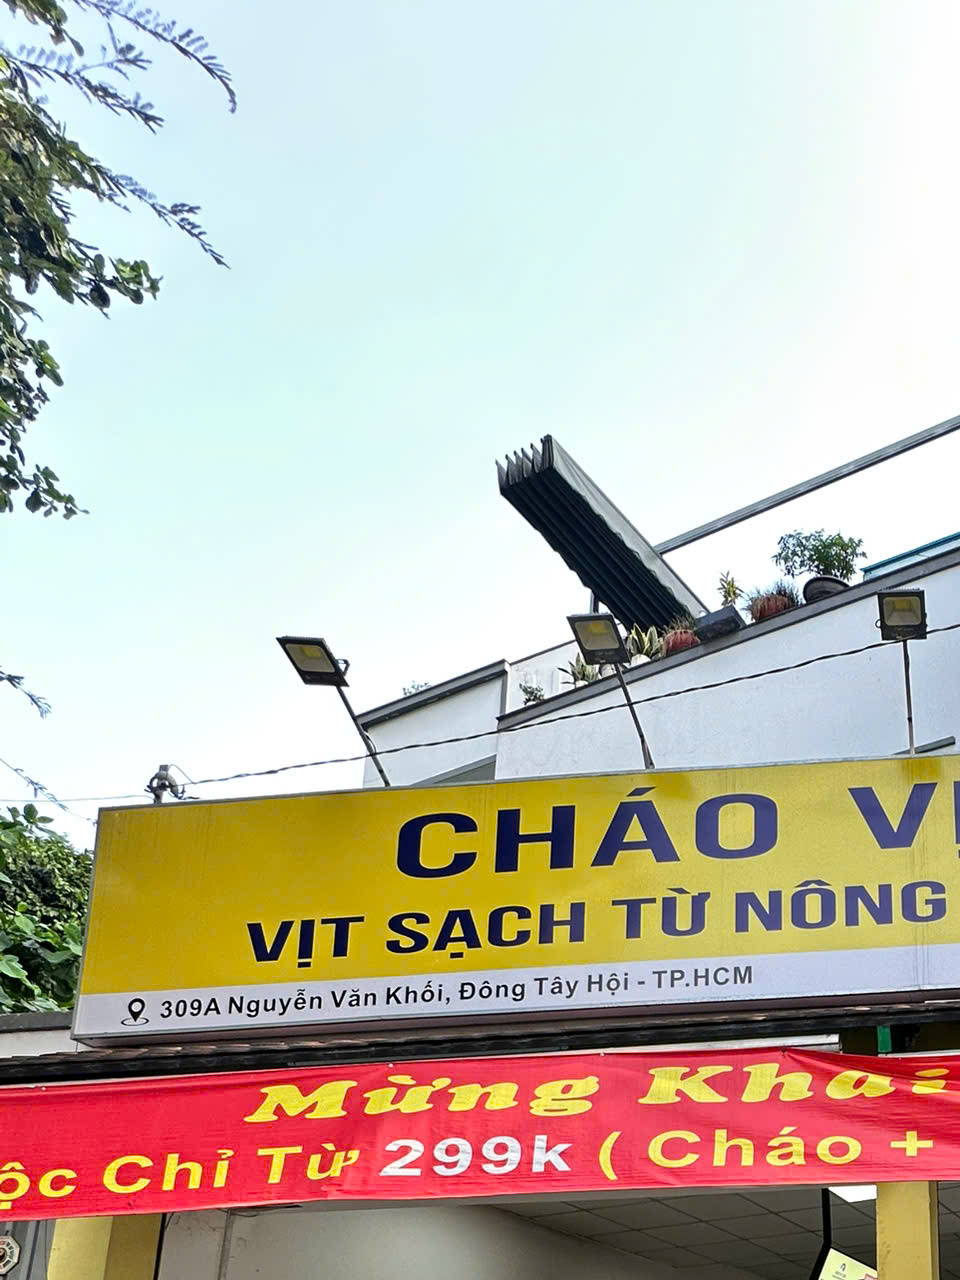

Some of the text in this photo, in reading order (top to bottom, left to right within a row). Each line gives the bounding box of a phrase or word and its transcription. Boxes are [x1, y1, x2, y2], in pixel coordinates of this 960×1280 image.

[397, 784, 779, 879] CHÁO
[247, 915, 365, 969] VỊT
[386, 902, 586, 959] SẠCH
[611, 886, 711, 939] TỪ
[736, 879, 947, 933] NÔNG
[159, 998, 221, 1019] 309A
[228, 987, 323, 1018] Nguyễn
[330, 987, 377, 1008] Văn
[385, 980, 452, 1005] Khối,
[458, 980, 527, 1002] Đông
[533, 975, 580, 999] Tây
[587, 973, 629, 996] Hội
[651, 965, 754, 989] TP.HCM
[246, 1075, 601, 1122] Mừng
[638, 1063, 950, 1104] Khai
[103, 1147, 230, 1194] Chỉ
[257, 1146, 360, 1184] Từ
[380, 1134, 573, 1178] 299k
[647, 1126, 863, 1168] Cháo
[890, 1130, 934, 1157] +
